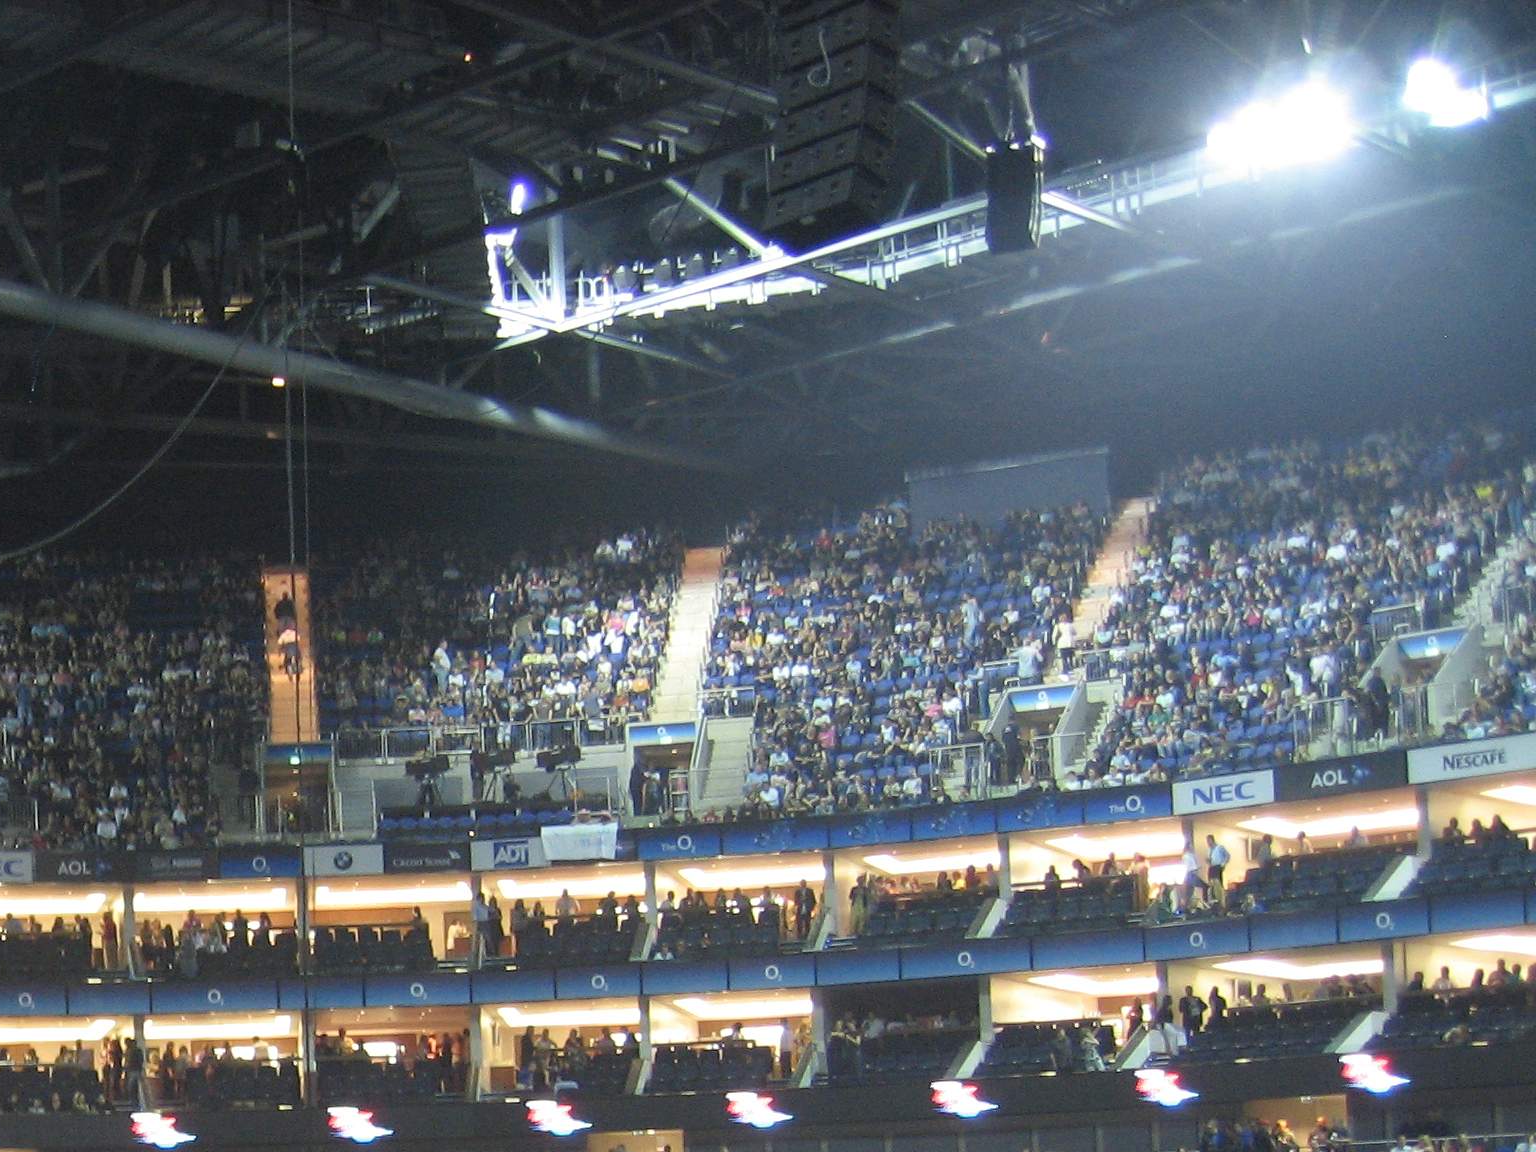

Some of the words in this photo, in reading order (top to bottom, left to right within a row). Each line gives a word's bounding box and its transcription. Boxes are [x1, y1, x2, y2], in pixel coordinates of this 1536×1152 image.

[1311, 769, 1348, 789] AOL
[1193, 780, 1255, 806] NEC
[1109, 804, 1125, 815] The
[494, 842, 528, 867] ADT
[57, 860, 91, 876] AOL
